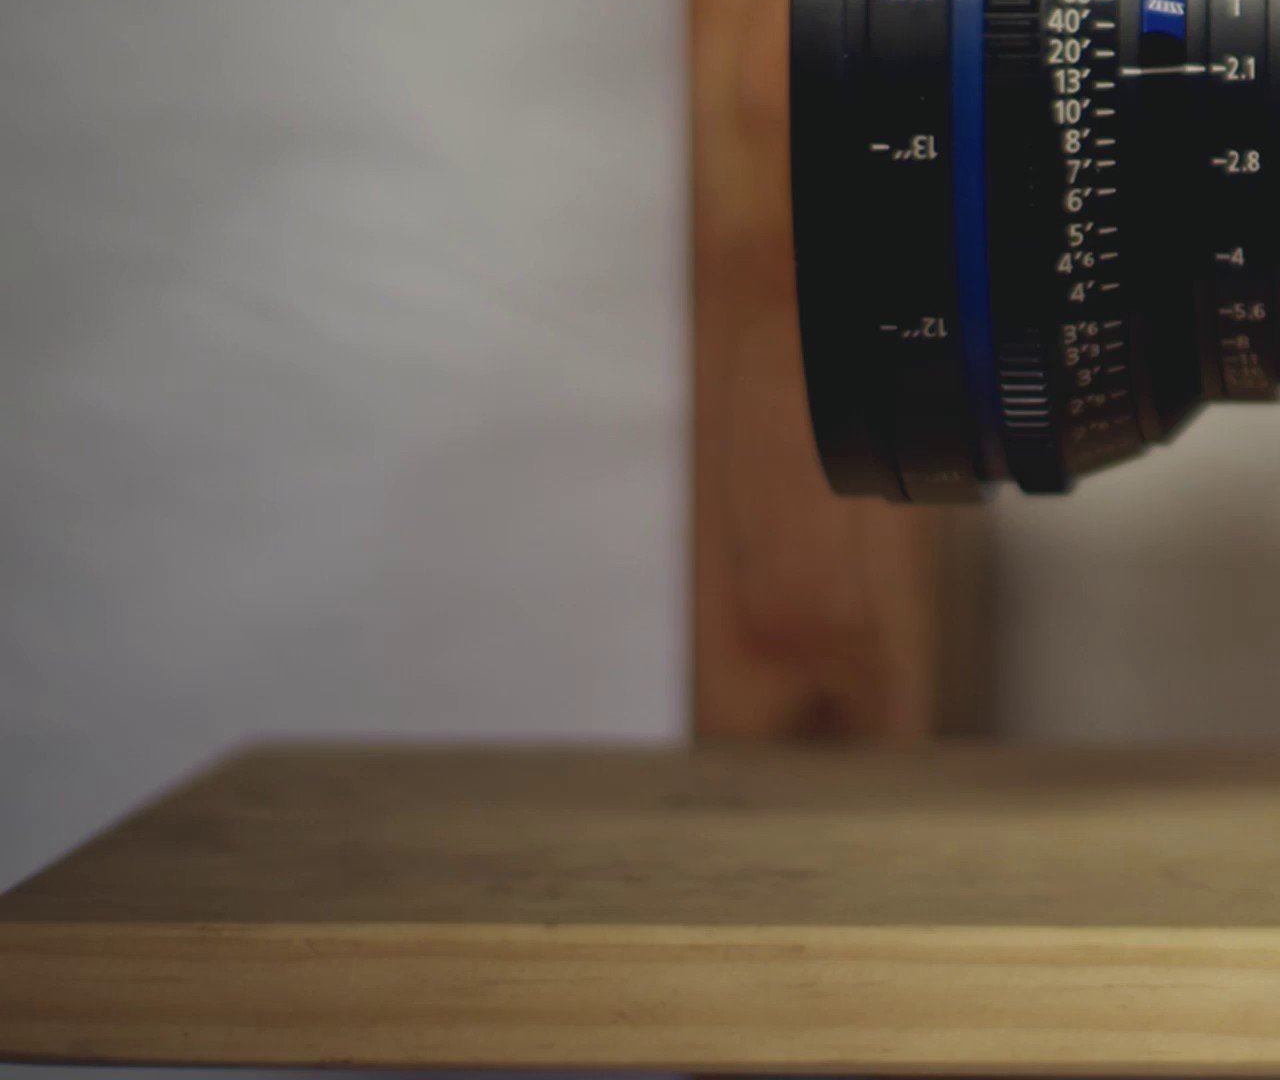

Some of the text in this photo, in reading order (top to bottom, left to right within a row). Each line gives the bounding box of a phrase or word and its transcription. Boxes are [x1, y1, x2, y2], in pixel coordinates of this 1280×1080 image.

[1046, 8, 1091, 33] 40'
[1047, 39, 1091, 63] 20'
[1054, 68, 1091, 93] 13'
[1053, 99, 1091, 124] 10'
[1064, 129, 1091, 153] 8'
[1066, 159, 1092, 183] 7'
[1065, 188, 1093, 212] 6'
[1068, 222, 1094, 246] 5'
